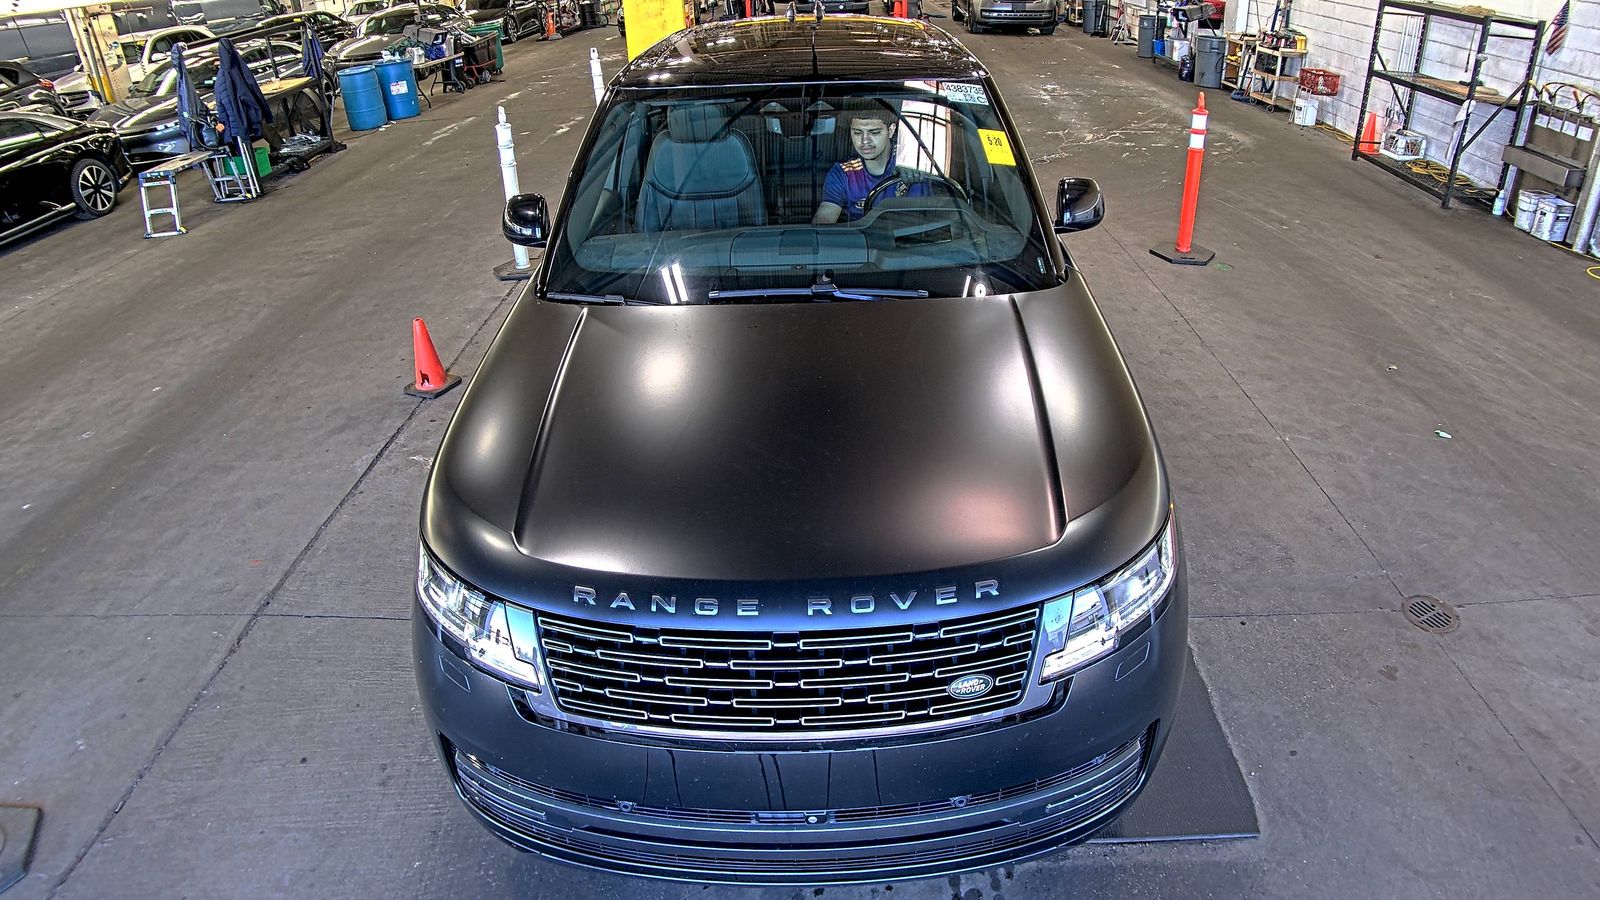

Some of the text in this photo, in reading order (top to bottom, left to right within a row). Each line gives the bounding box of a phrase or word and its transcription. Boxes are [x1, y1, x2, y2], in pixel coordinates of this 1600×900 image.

[945, 84, 985, 95] 4383735
[573, 579, 1000, 616] RANGE ROVER
[957, 678, 980, 689] LAND
[960, 683, 986, 694] ROVER
